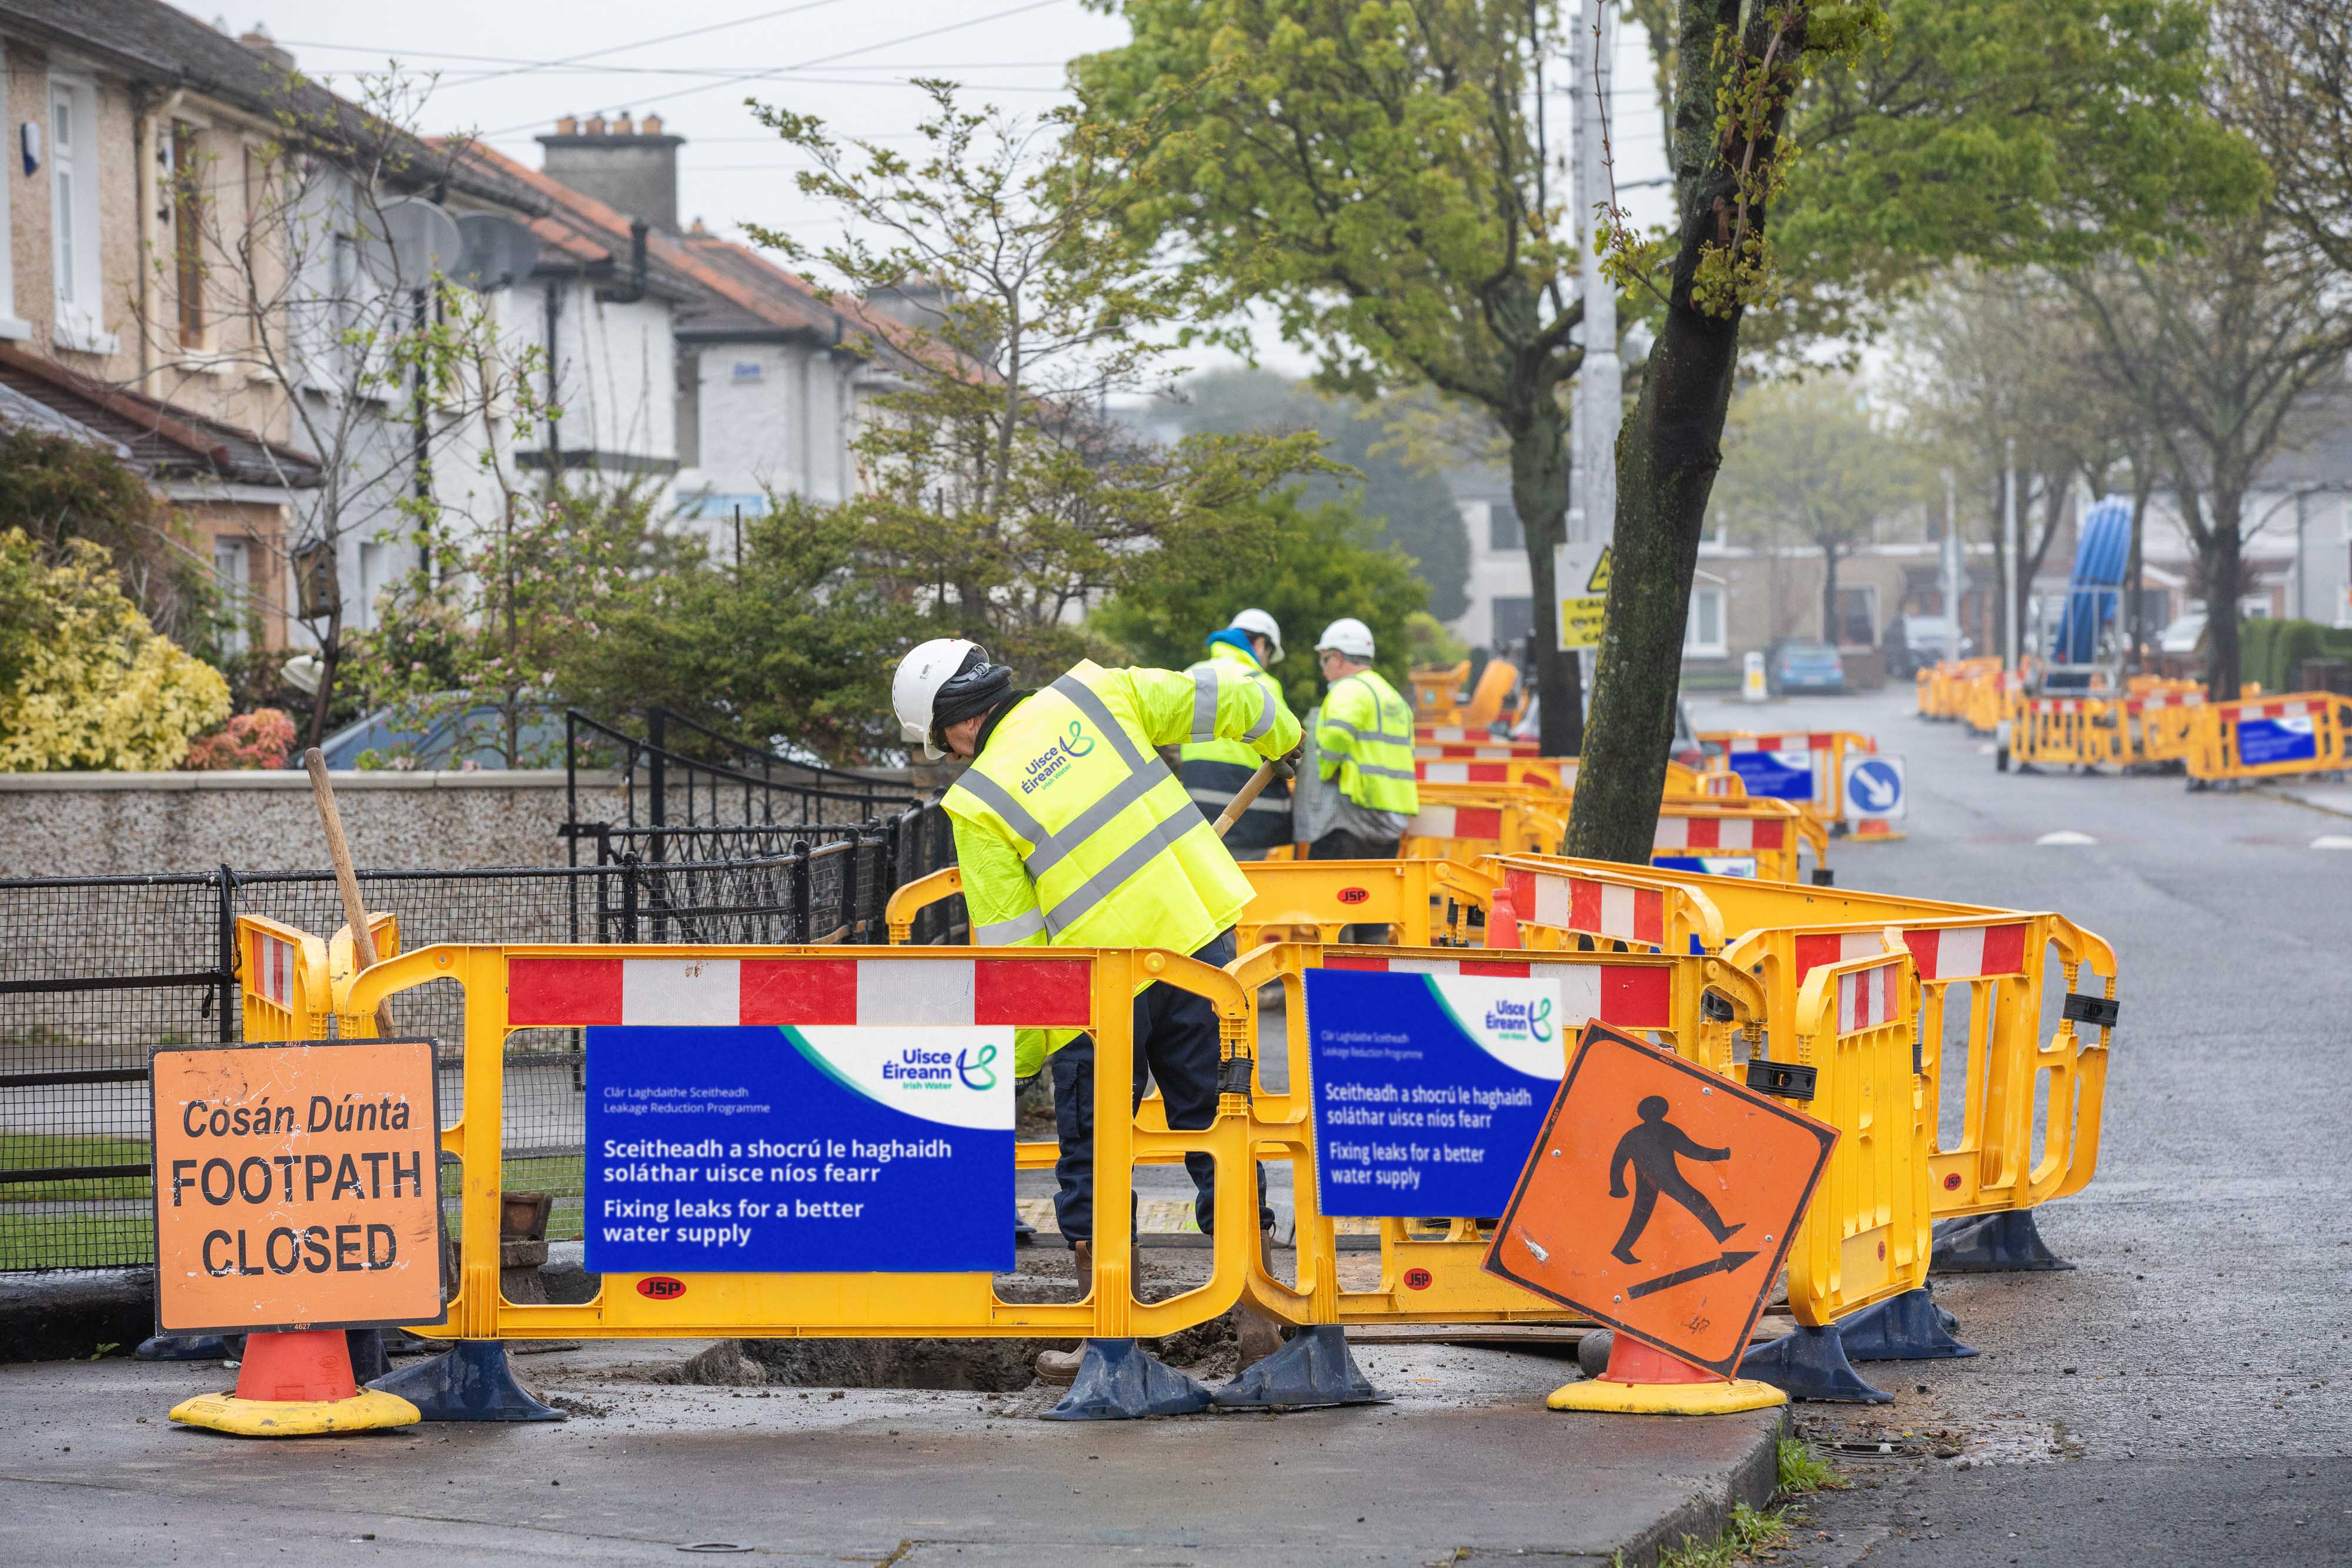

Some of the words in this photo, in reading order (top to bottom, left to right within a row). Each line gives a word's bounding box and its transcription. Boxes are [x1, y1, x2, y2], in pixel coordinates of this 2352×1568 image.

[1025, 747, 1058, 775] Uisce
[1021, 755, 1067, 794] Éireann
[1041, 778, 1055, 790] Irish
[1053, 763, 1071, 779] Water
[1342, 891, 1366, 901] JSP
[1496, 999, 1526, 1015] Uisce
[1485, 1008, 1527, 1029] Éireann
[903, 1048, 952, 1065] Uisce
[883, 1059, 952, 1079] Éireann
[604, 1086, 626, 1098] Clár
[628, 1086, 687, 1100] Laghdaithe
[690, 1086, 749, 1098] Sceitheadh
[903, 1081, 923, 1090] Irish
[924, 1081, 953, 1090] Water
[1326, 1082, 1398, 1103] Sceitheadh
[1401, 1089, 1409, 1103] a
[1412, 1086, 1455, 1105] shocrú
[1458, 1087, 1471, 1105] le
[1473, 1088, 1532, 1111] haghaidh
[184, 1096, 295, 1138] Cosán
[307, 1094, 410, 1133] Dúnta
[604, 1102, 648, 1115] Leakage
[650, 1102, 704, 1113] Reduction
[707, 1102, 770, 1115] Programme
[1327, 1107, 1385, 1126] soláthar
[1388, 1108, 1424, 1126] uisce
[1427, 1109, 1456, 1127] níos
[1458, 1112, 1492, 1128] fearr
[604, 1139, 723, 1158] Sceitheadh
[729, 1144, 742, 1158] a
[747, 1139, 821, 1158] shocrú
[827, 1139, 846, 1158] le
[852, 1139, 951, 1162] haghaidh
[1329, 1142, 1371, 1165] Fixing
[1373, 1143, 1408, 1161] leaks
[1410, 1144, 1430, 1162] for
[1433, 1149, 1442, 1162] a
[1444, 1146, 1485, 1163] better
[172, 1151, 422, 1207] FOOTPATH
[603, 1163, 699, 1182] soláthar
[706, 1164, 764, 1182] uisce
[771, 1163, 817, 1182] níos
[824, 1163, 881, 1182] fearr
[1331, 1167, 1373, 1184] water
[1375, 1168, 1421, 1189] supply
[1947, 1176, 1960, 1187] JSP
[604, 1199, 669, 1222] Fixing
[675, 1199, 732, 1218] leaks
[738, 1199, 770, 1218] for
[776, 1203, 789, 1218] a
[796, 1199, 864, 1218] better
[603, 1224, 670, 1242] water
[676, 1224, 751, 1246] supply
[202, 1224, 397, 1276] CLOSED
[644, 1281, 681, 1295] JSP
[1408, 1273, 1429, 1286] JSP
